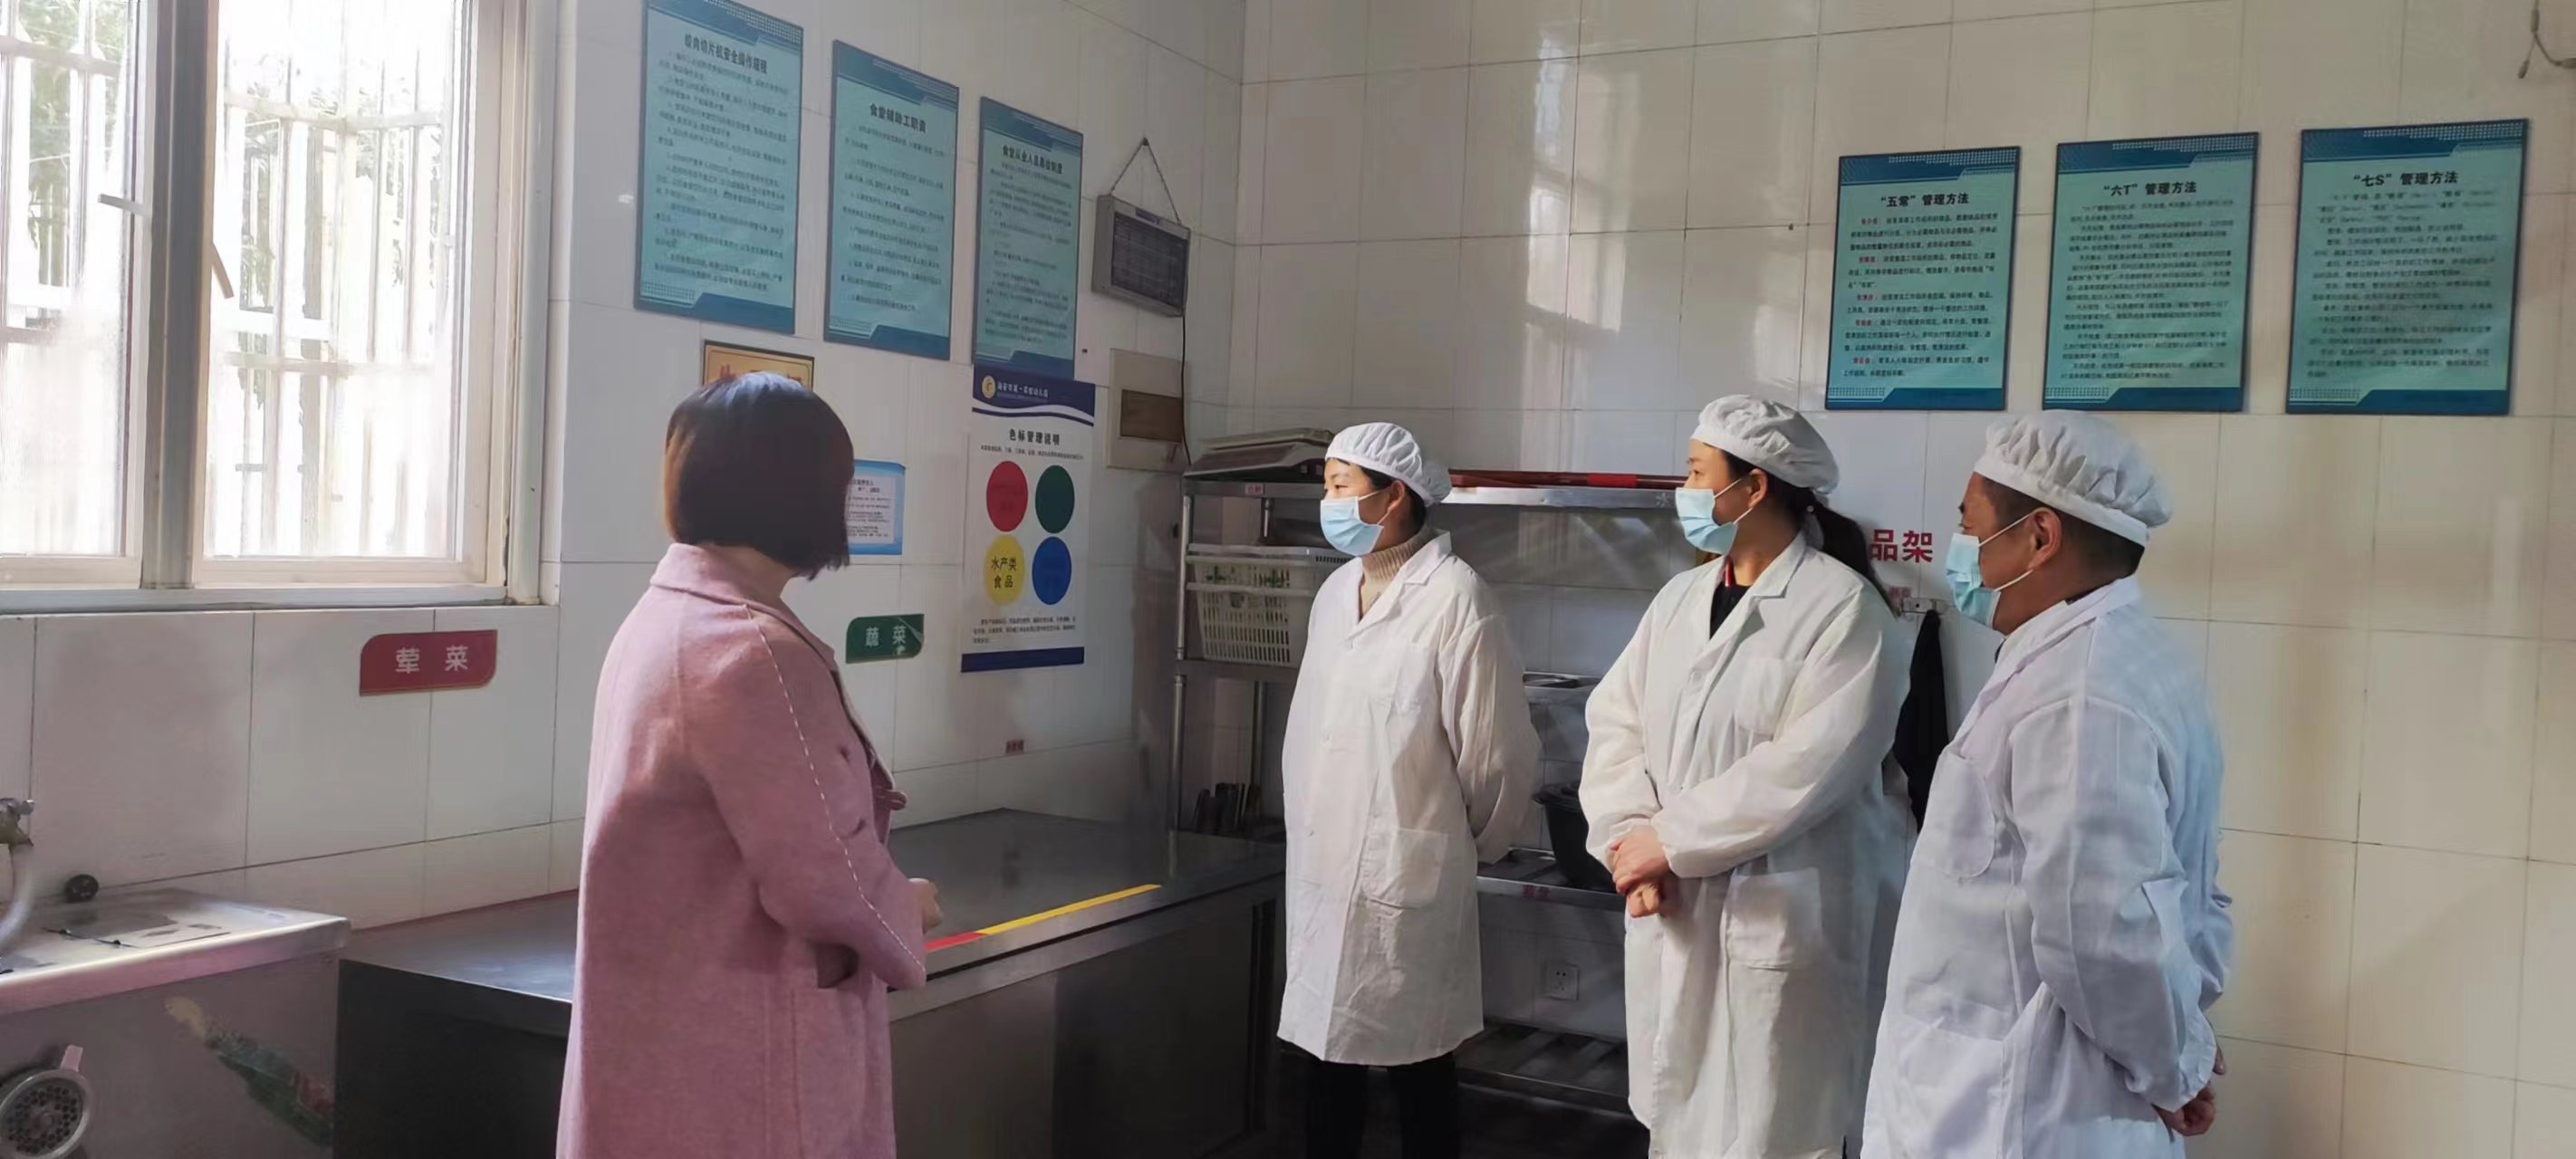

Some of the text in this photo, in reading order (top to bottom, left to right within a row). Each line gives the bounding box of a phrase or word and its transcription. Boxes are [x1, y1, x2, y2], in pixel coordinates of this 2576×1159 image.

[870, 102, 927, 133] 食堂辅助工职责
[1008, 428, 1061, 445] 色标管理说明
[1870, 529, 1933, 563] 品架
[991, 556, 1017, 572] 水产类
[994, 575, 1014, 589] 食品
[865, 625, 907, 647] 蔬菜
[395, 644, 468, 674] 荤菜
